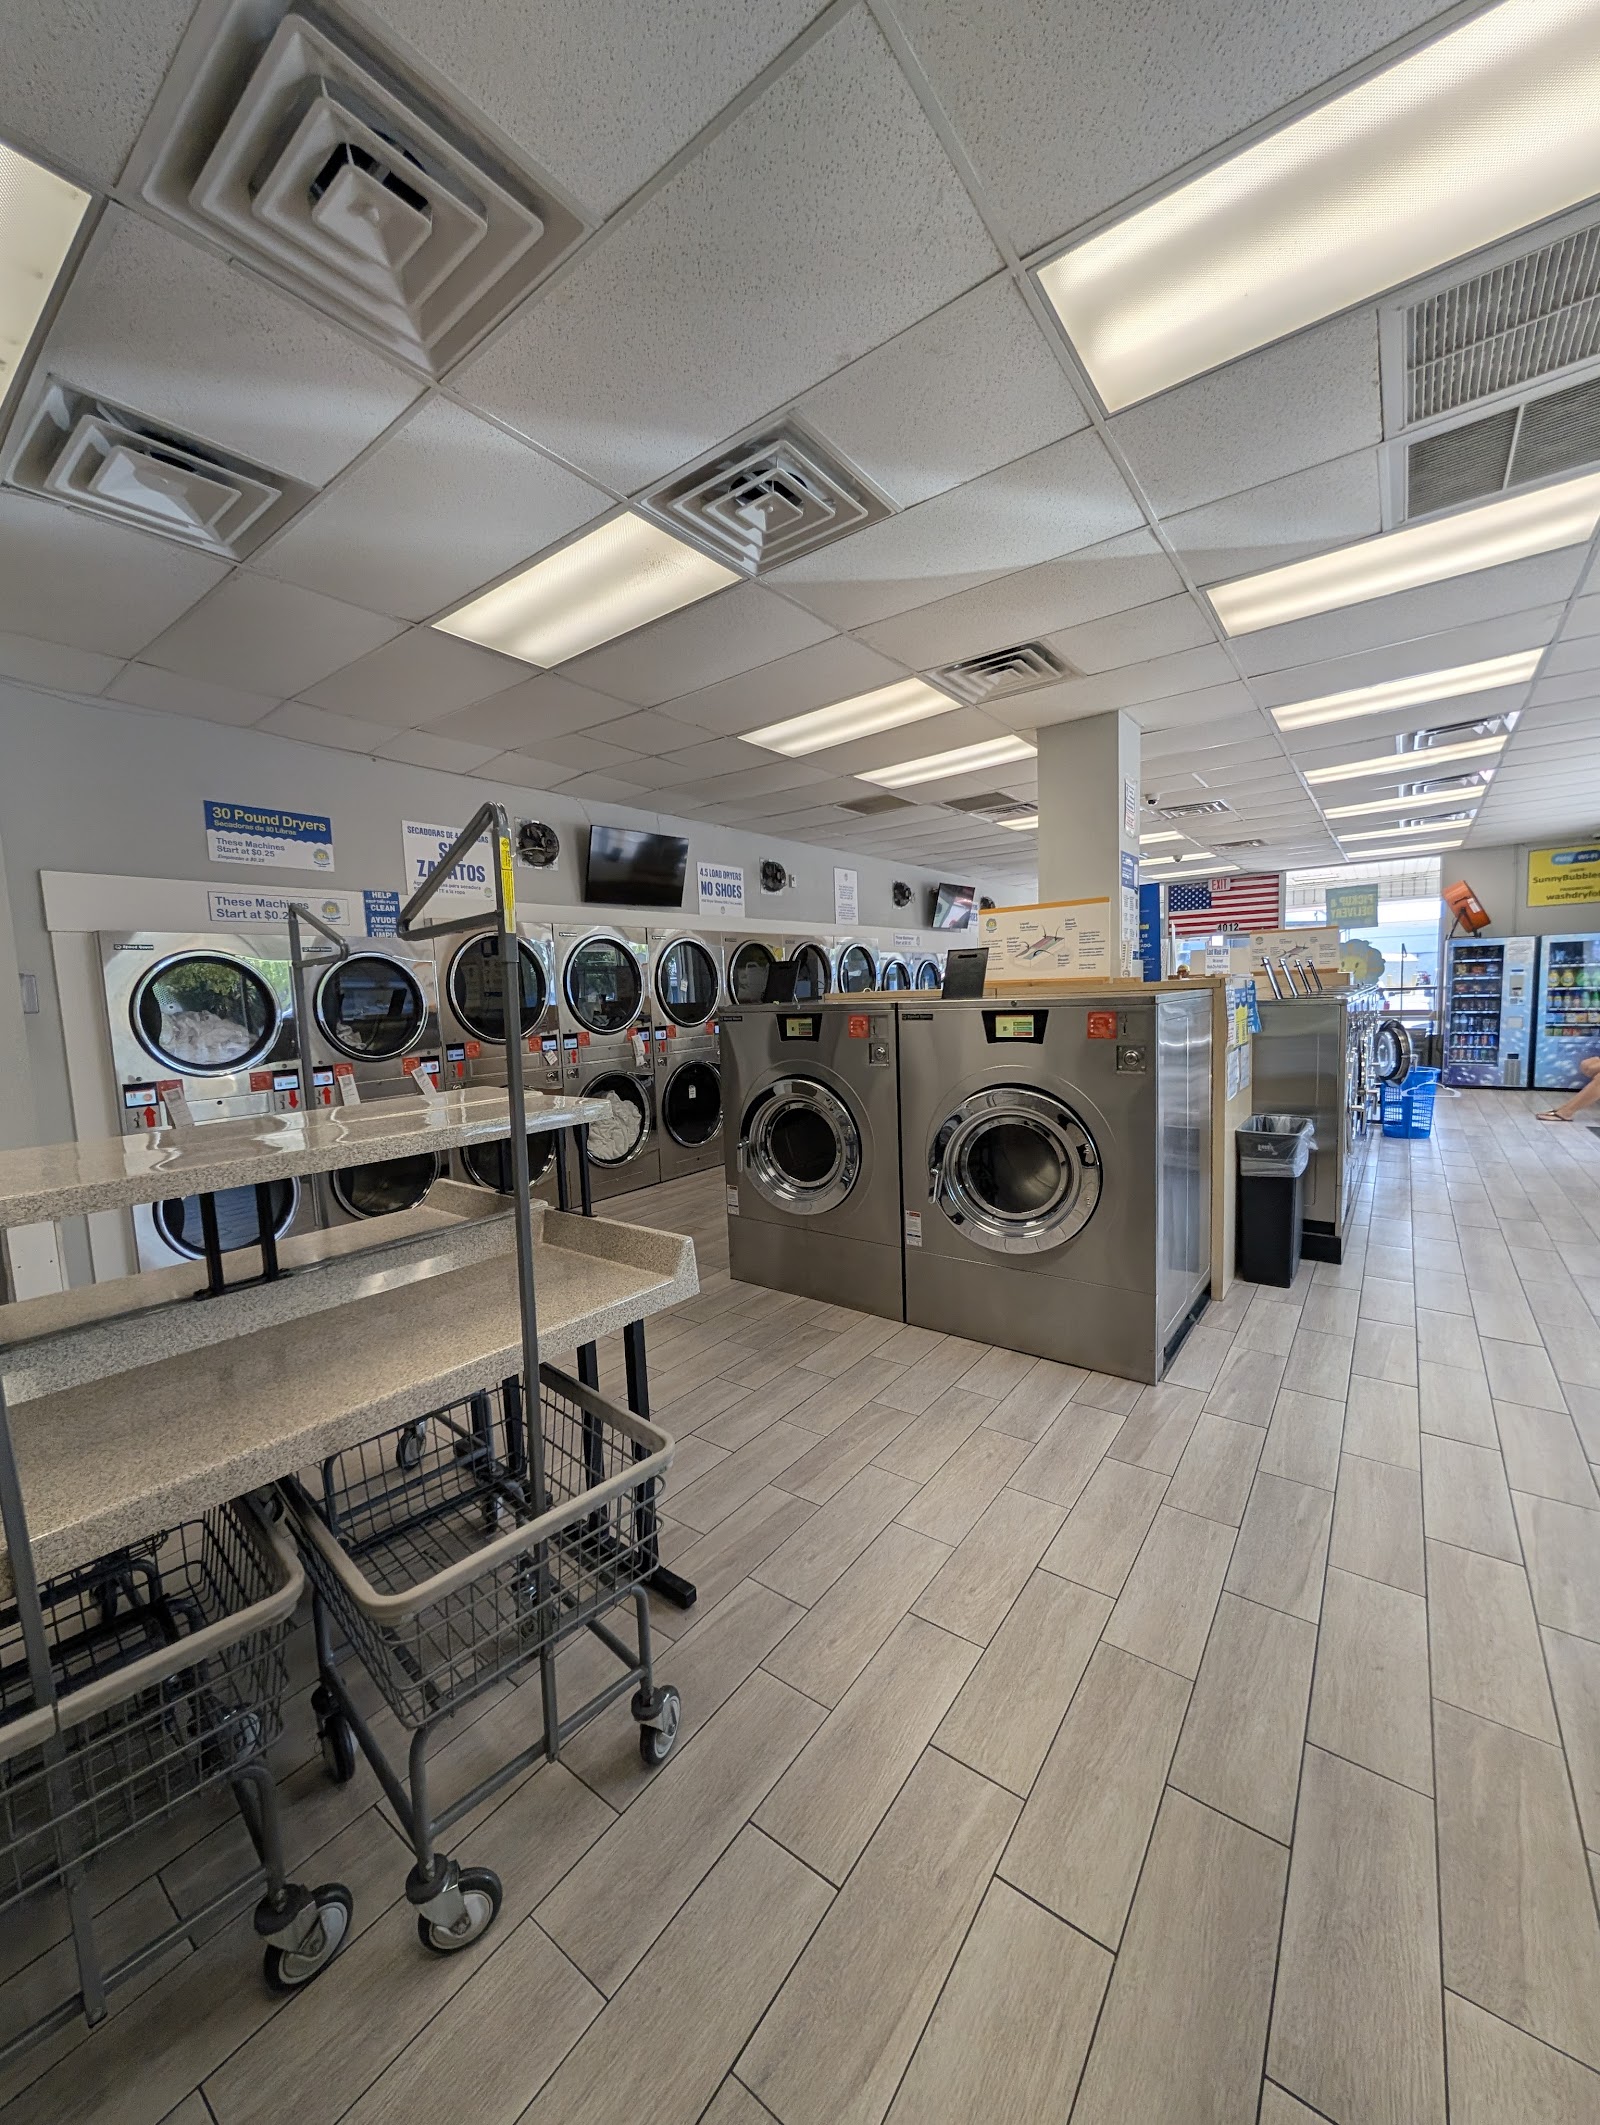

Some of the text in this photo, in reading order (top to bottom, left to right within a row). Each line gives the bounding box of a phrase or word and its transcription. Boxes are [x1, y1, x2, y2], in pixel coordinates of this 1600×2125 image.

[212, 806, 327, 832] 30 Pound Dryers
[214, 820, 254, 830] Secadoras
[275, 827, 297, 836] Libras
[407, 825, 445, 838] SECADORAS
[446, 831, 453, 839] DE
[216, 837, 285, 851] These Machines
[217, 845, 239, 854] Start
[251, 849, 275, 857] $0.25
[416, 859, 486, 882] ZAATOS
[700, 868, 742, 881] 4.5 LOAD DRYERS
[701, 881, 742, 899] NO SHOES
[1211, 878, 1227, 890] EXIT
[215, 896, 252, 907] These
[371, 904, 396, 912] CLEAN
[216, 908, 289, 921] Start at $0.2
[371, 916, 397, 924] AYUDE
[1217, 922, 1239, 932] 4012
